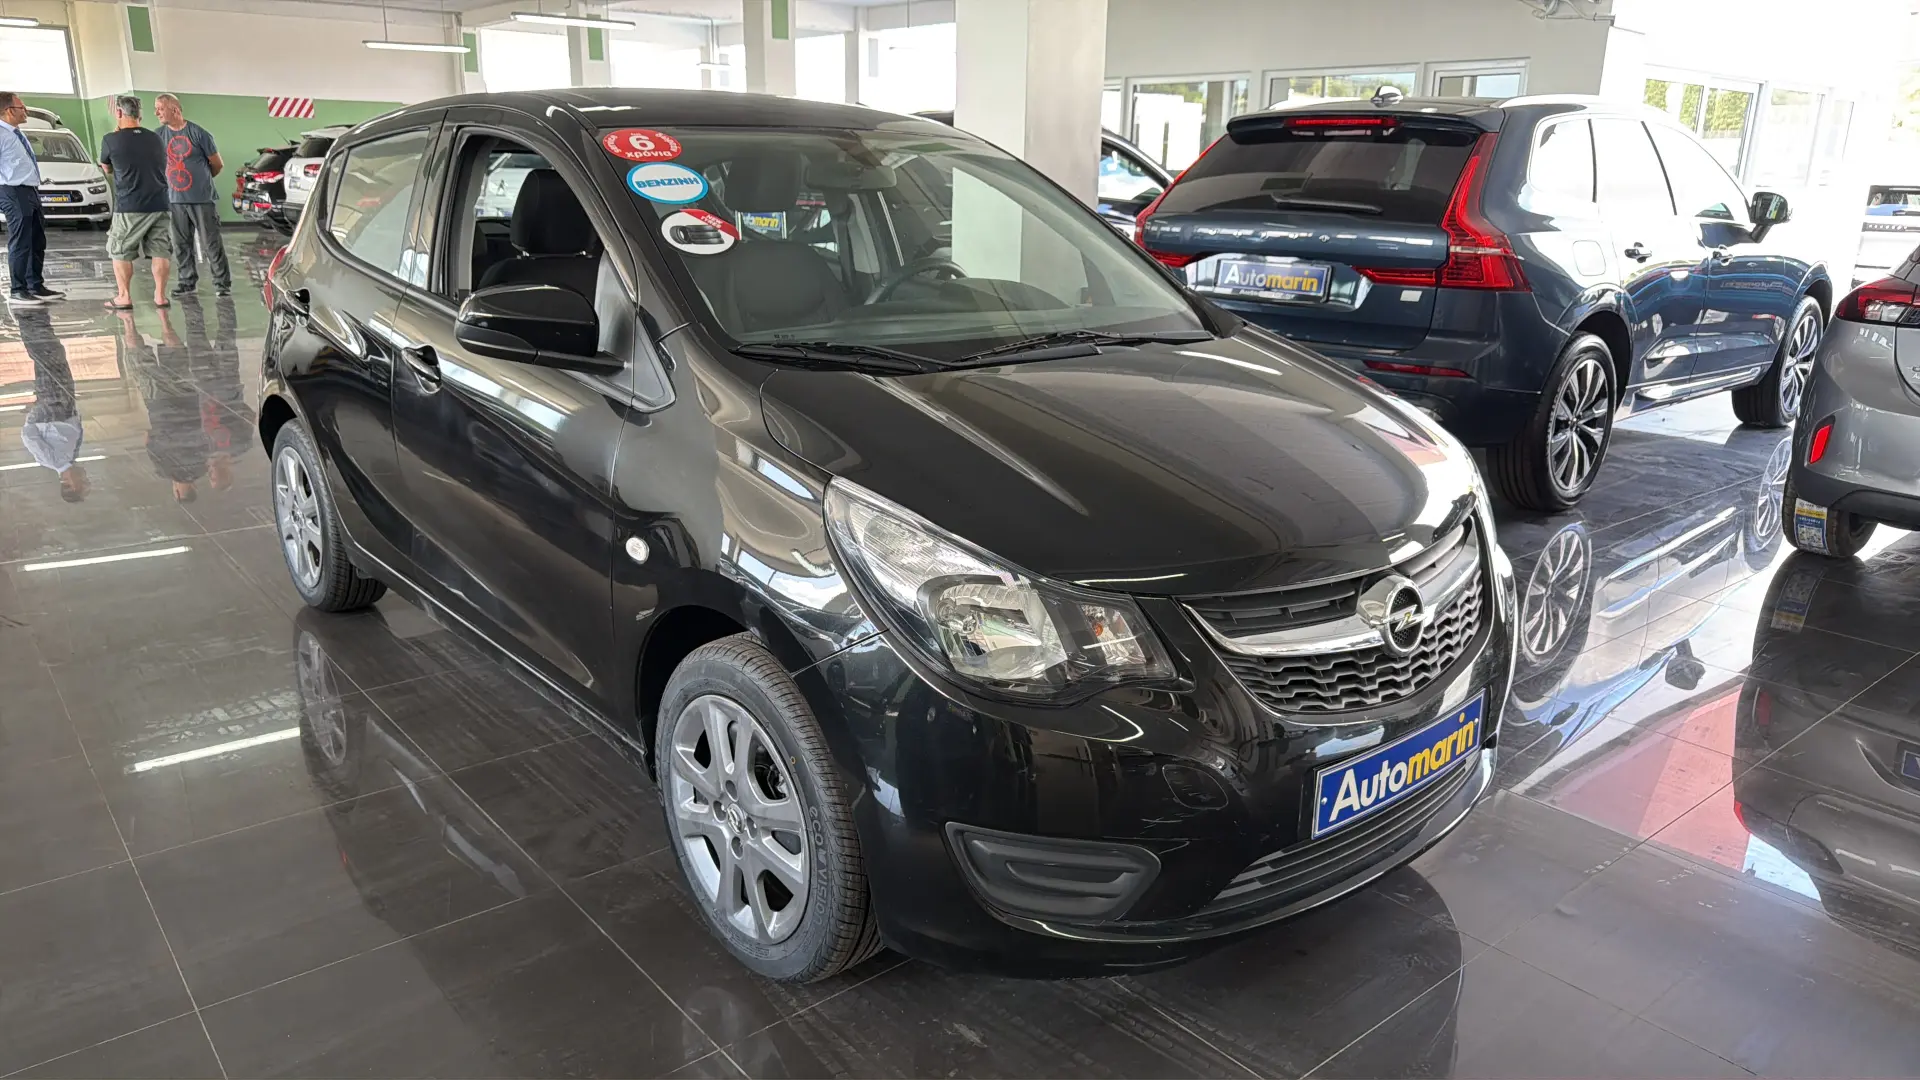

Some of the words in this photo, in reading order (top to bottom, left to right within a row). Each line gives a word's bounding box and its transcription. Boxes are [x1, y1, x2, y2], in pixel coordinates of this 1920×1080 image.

[629, 135, 655, 150] 6
[625, 150, 672, 158] χρόνια
[41, 195, 68, 204] utomarin
[1223, 264, 1318, 291] Automarin
[1328, 712, 1475, 822] Automarin
